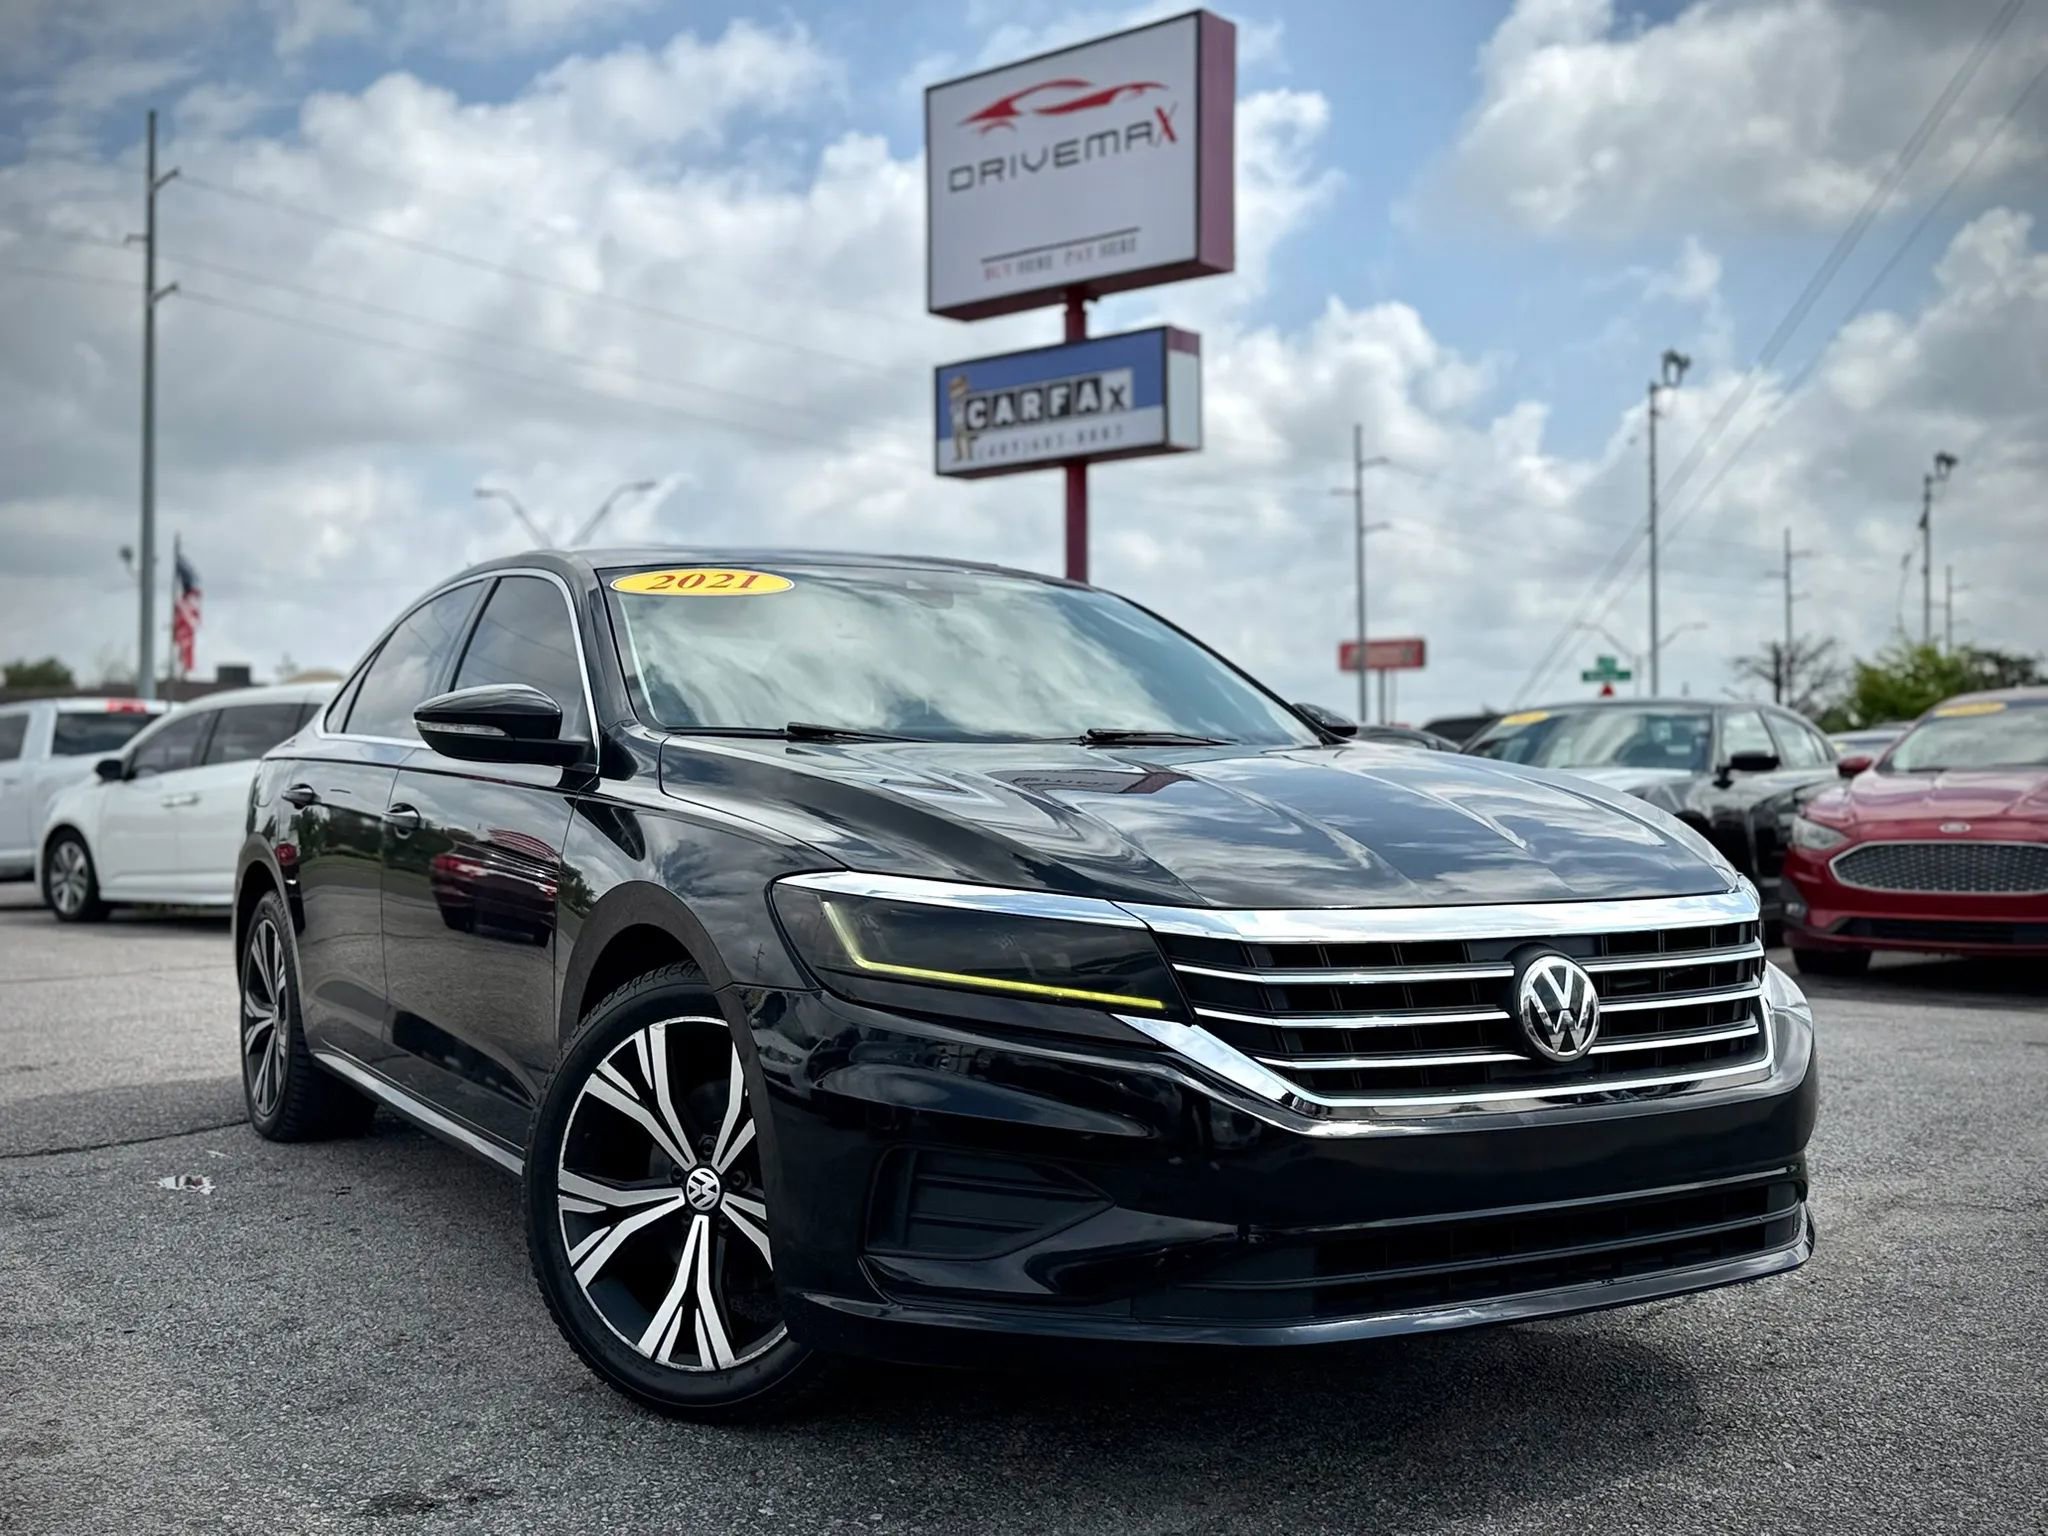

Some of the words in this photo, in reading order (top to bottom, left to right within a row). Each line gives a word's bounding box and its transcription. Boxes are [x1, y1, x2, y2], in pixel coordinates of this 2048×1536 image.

[948, 102, 1178, 194] DRIVEMAX
[966, 378, 1129, 430] CARFAX
[645, 573, 760, 591] 2021
